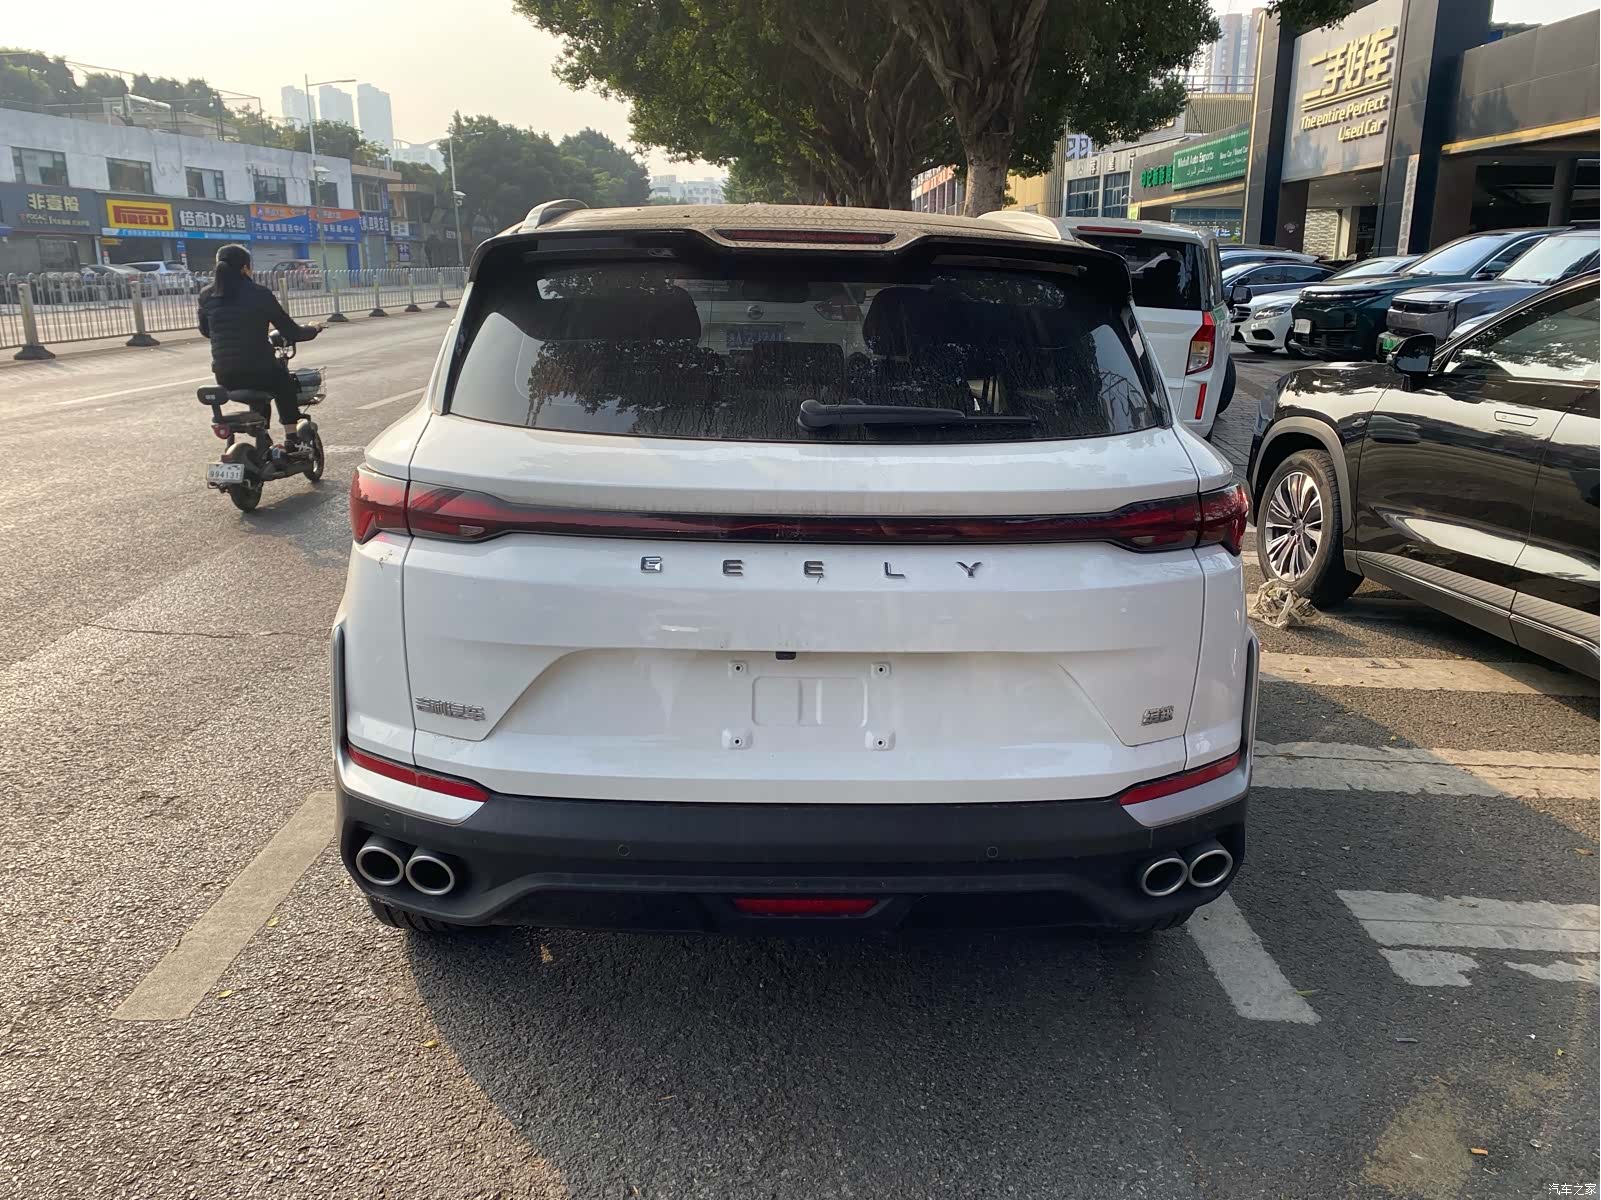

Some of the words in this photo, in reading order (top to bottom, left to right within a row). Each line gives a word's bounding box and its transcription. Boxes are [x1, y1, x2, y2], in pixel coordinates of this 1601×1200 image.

[1303, 26, 1398, 101] 二手好车
[1300, 116, 1317, 130] The
[1317, 107, 1346, 125] entire
[1347, 96, 1387, 118] Perfect
[1338, 124, 1367, 141] Used
[1365, 119, 1386, 134] Car
[112, 205, 169, 226] PIRELLI
[179, 210, 246, 229] 倍耐力轮胎
[640, 556, 983, 579] GEELY
[415, 696, 486, 721] 吉利汽车
